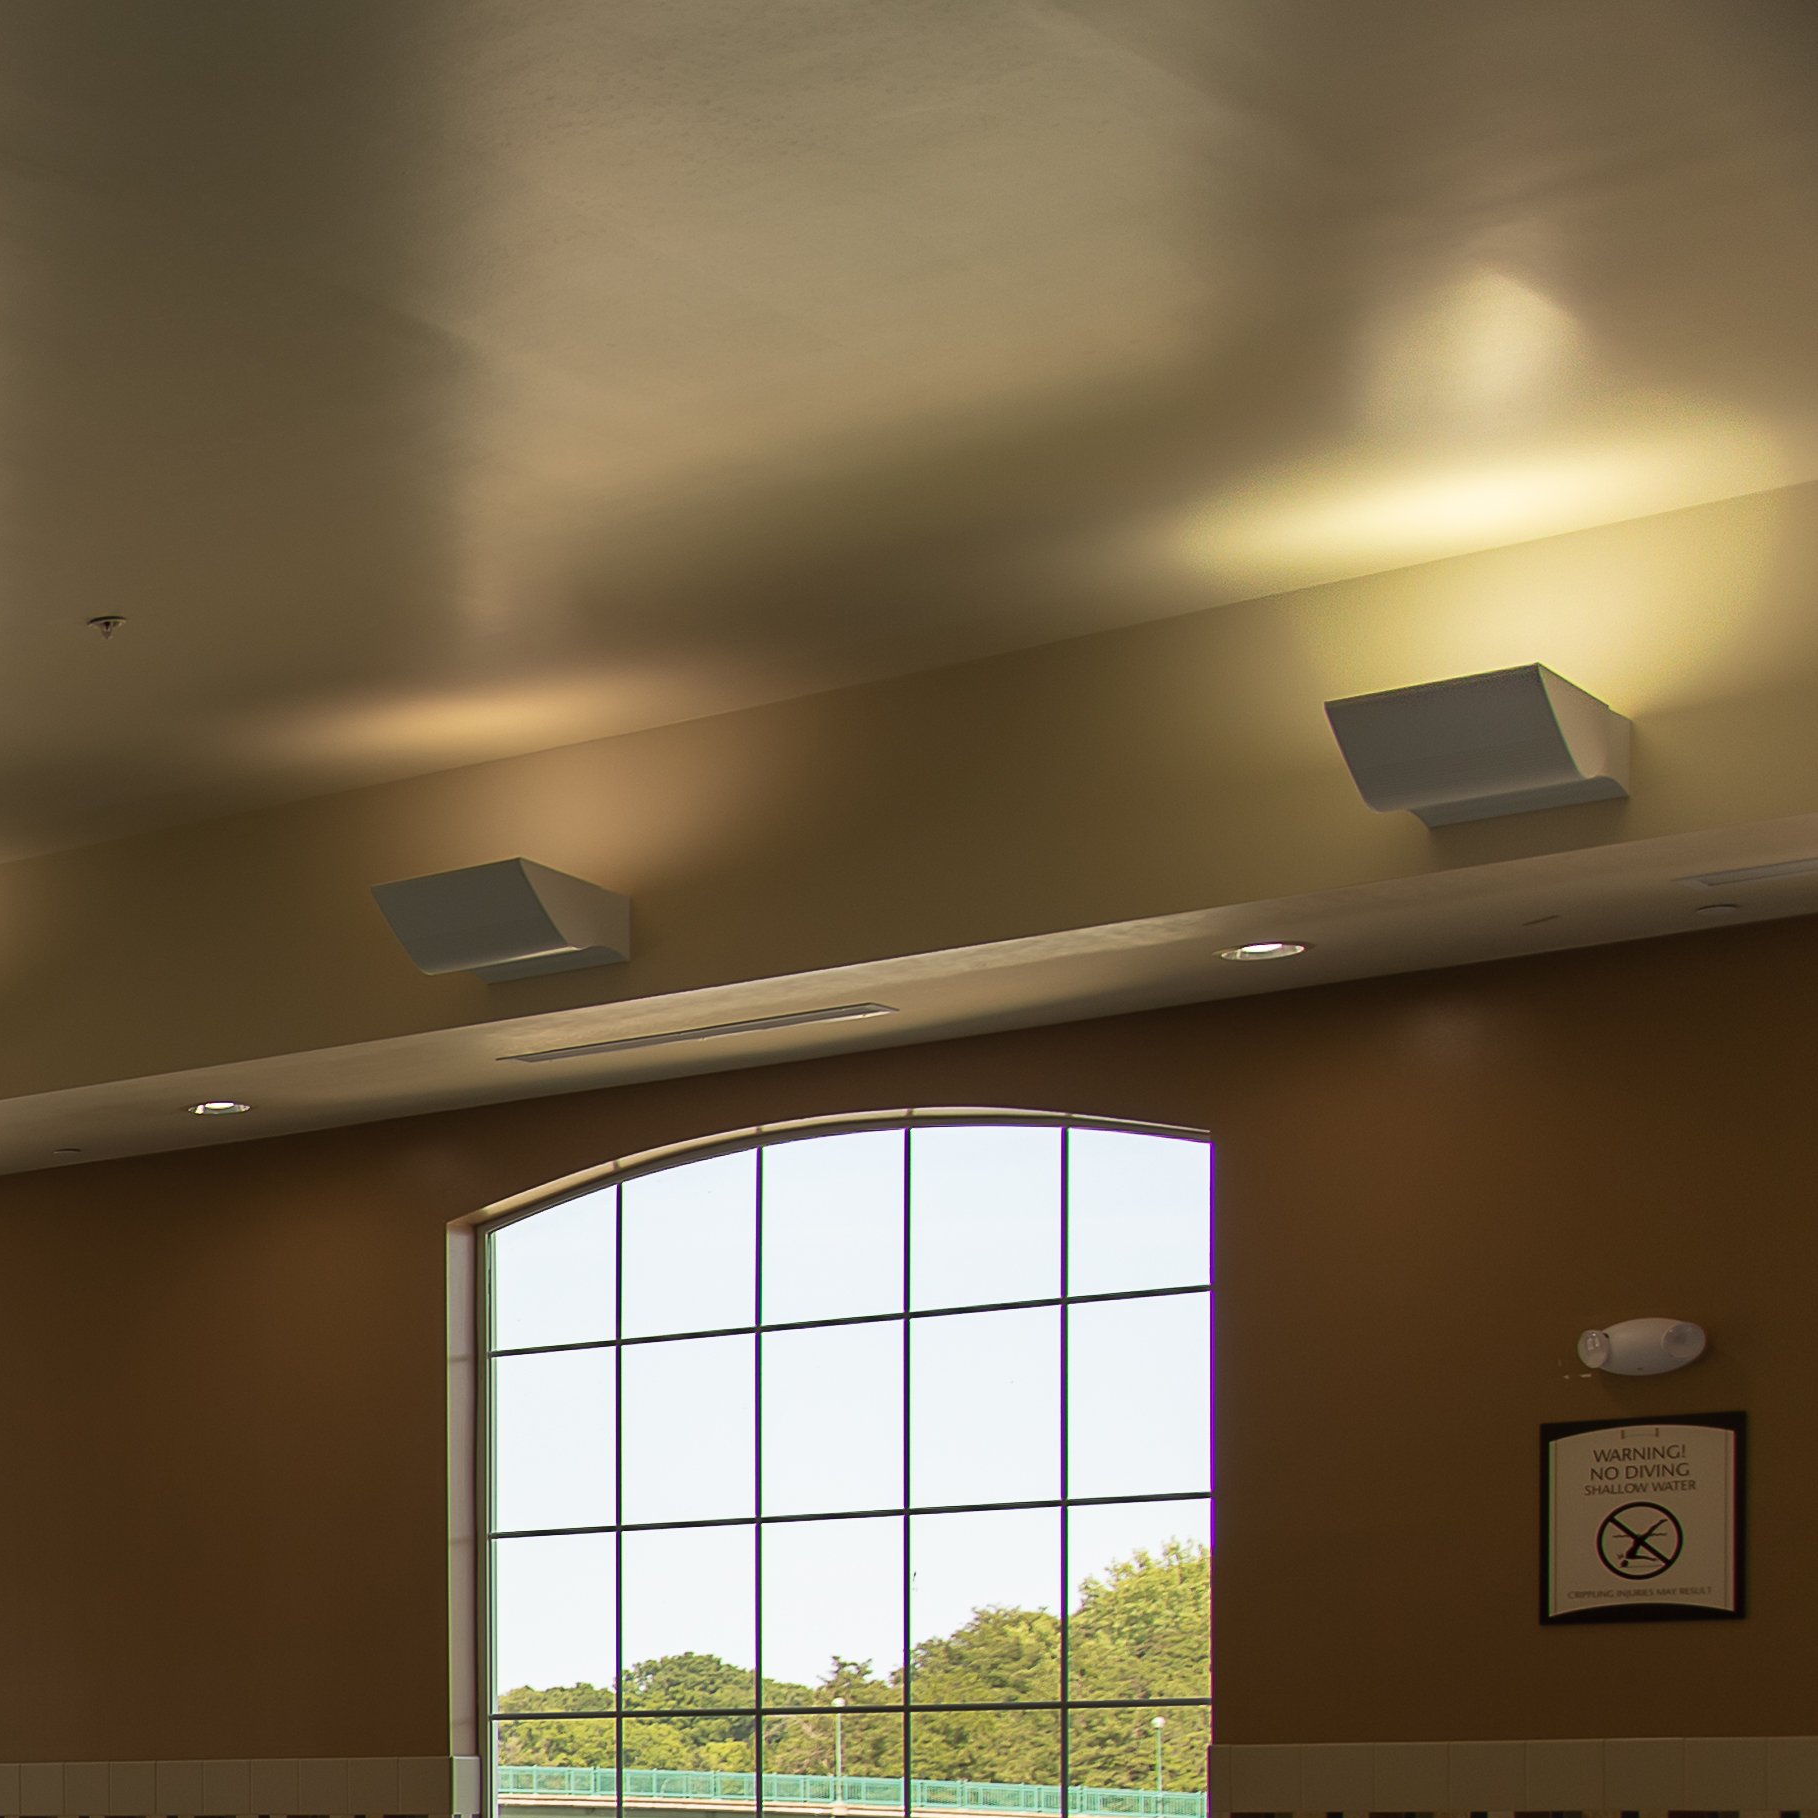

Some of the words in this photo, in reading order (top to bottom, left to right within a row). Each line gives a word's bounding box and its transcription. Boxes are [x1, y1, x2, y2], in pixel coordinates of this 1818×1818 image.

[1593, 1444, 1686, 1462] WARNING!
[1590, 1466, 1619, 1481] NO
[1625, 1462, 1691, 1479] DIVING
[1584, 1482, 1650, 1496] SHALLOW
[1652, 1480, 1697, 1492] WATER
[1567, 1589, 1614, 1599] CRIPPLING
[1617, 1588, 1654, 1598] INJURIES
[1656, 1587, 1676, 1596] MAY
[1679, 1586, 1712, 1595] RESULT
